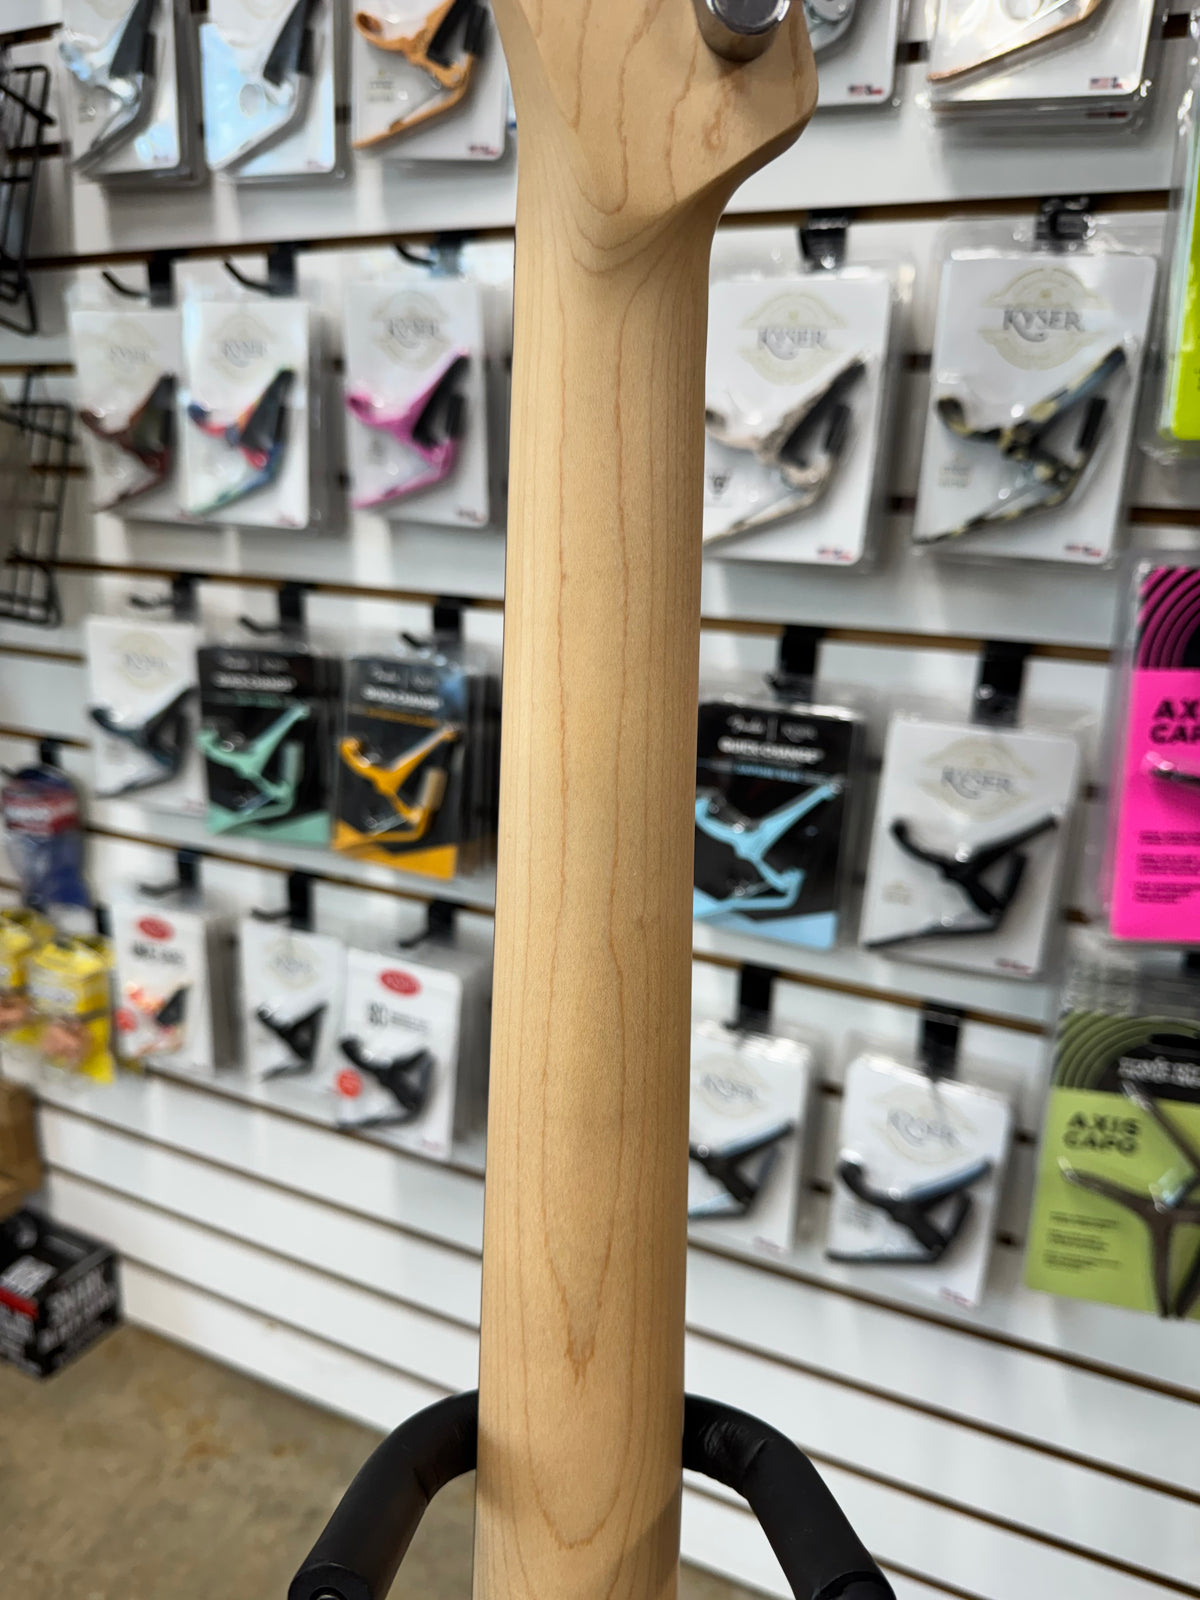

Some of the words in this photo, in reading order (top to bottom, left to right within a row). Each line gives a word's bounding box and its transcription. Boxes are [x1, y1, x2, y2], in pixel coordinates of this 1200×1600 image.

[1003, 309, 1085, 342] KYSER
[1153, 699, 1199, 720] AX
[1067, 1111, 1139, 1136] AXIS
[1063, 1130, 1137, 1156] CAPO
